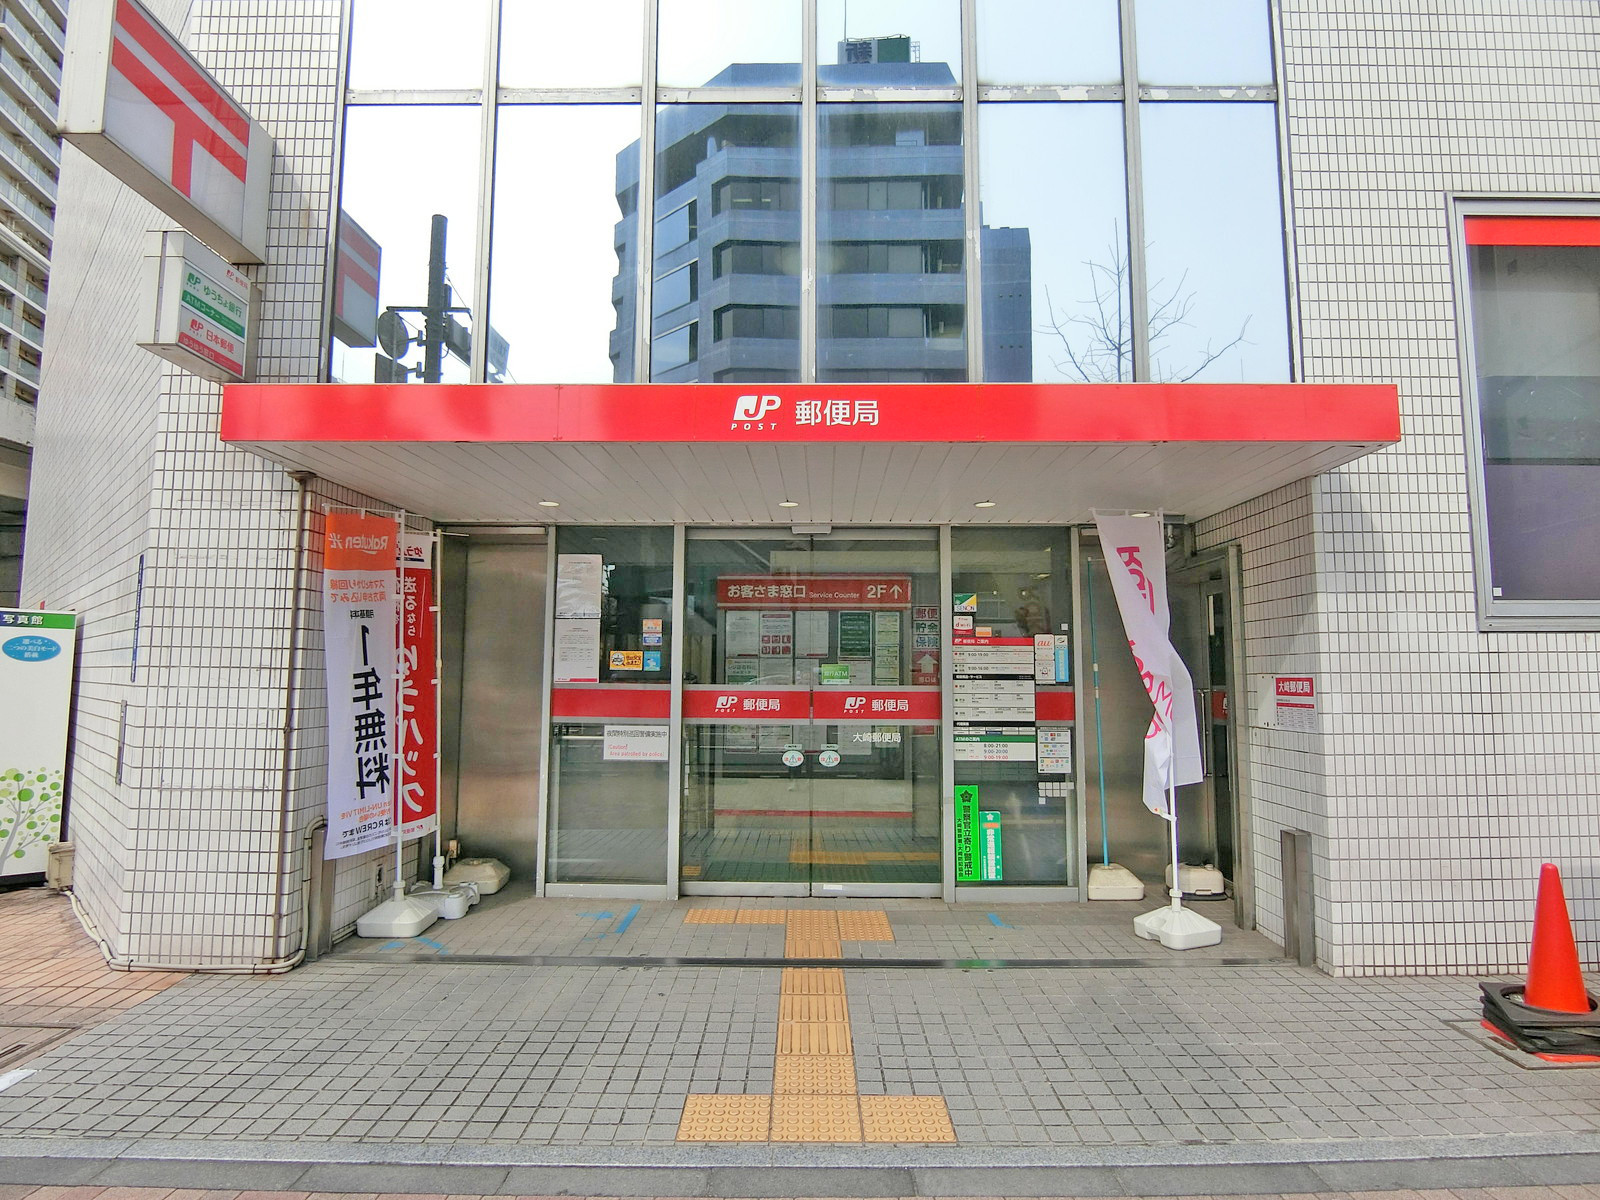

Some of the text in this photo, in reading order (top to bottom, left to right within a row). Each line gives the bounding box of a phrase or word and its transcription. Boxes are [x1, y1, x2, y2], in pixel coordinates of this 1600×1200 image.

[186, 293, 220, 319] ATMコーナー
[203, 285, 242, 318] ゆうちょ銀行
[207, 329, 234, 354] 日本郵便
[733, 395, 879, 426] JP 郵便局
[731, 423, 777, 431] POST
[727, 585, 806, 599] お客さま窓口
[809, 591, 833, 599] Service
[867, 585, 886, 599] 2F
[3, 615, 43, 625] 写真館
[916, 607, 938, 619] 郵便
[916, 622, 938, 633] 貯金
[916, 636, 938, 648] 保険
[1278, 681, 1310, 693] 大崎郵便局
[716, 696, 780, 712] JP 郵便局
[845, 697, 909, 712] JP 郵便局
[852, 732, 901, 743] 大崎郵便局
[963, 805, 973, 877] 警察官立寄り警戒中
